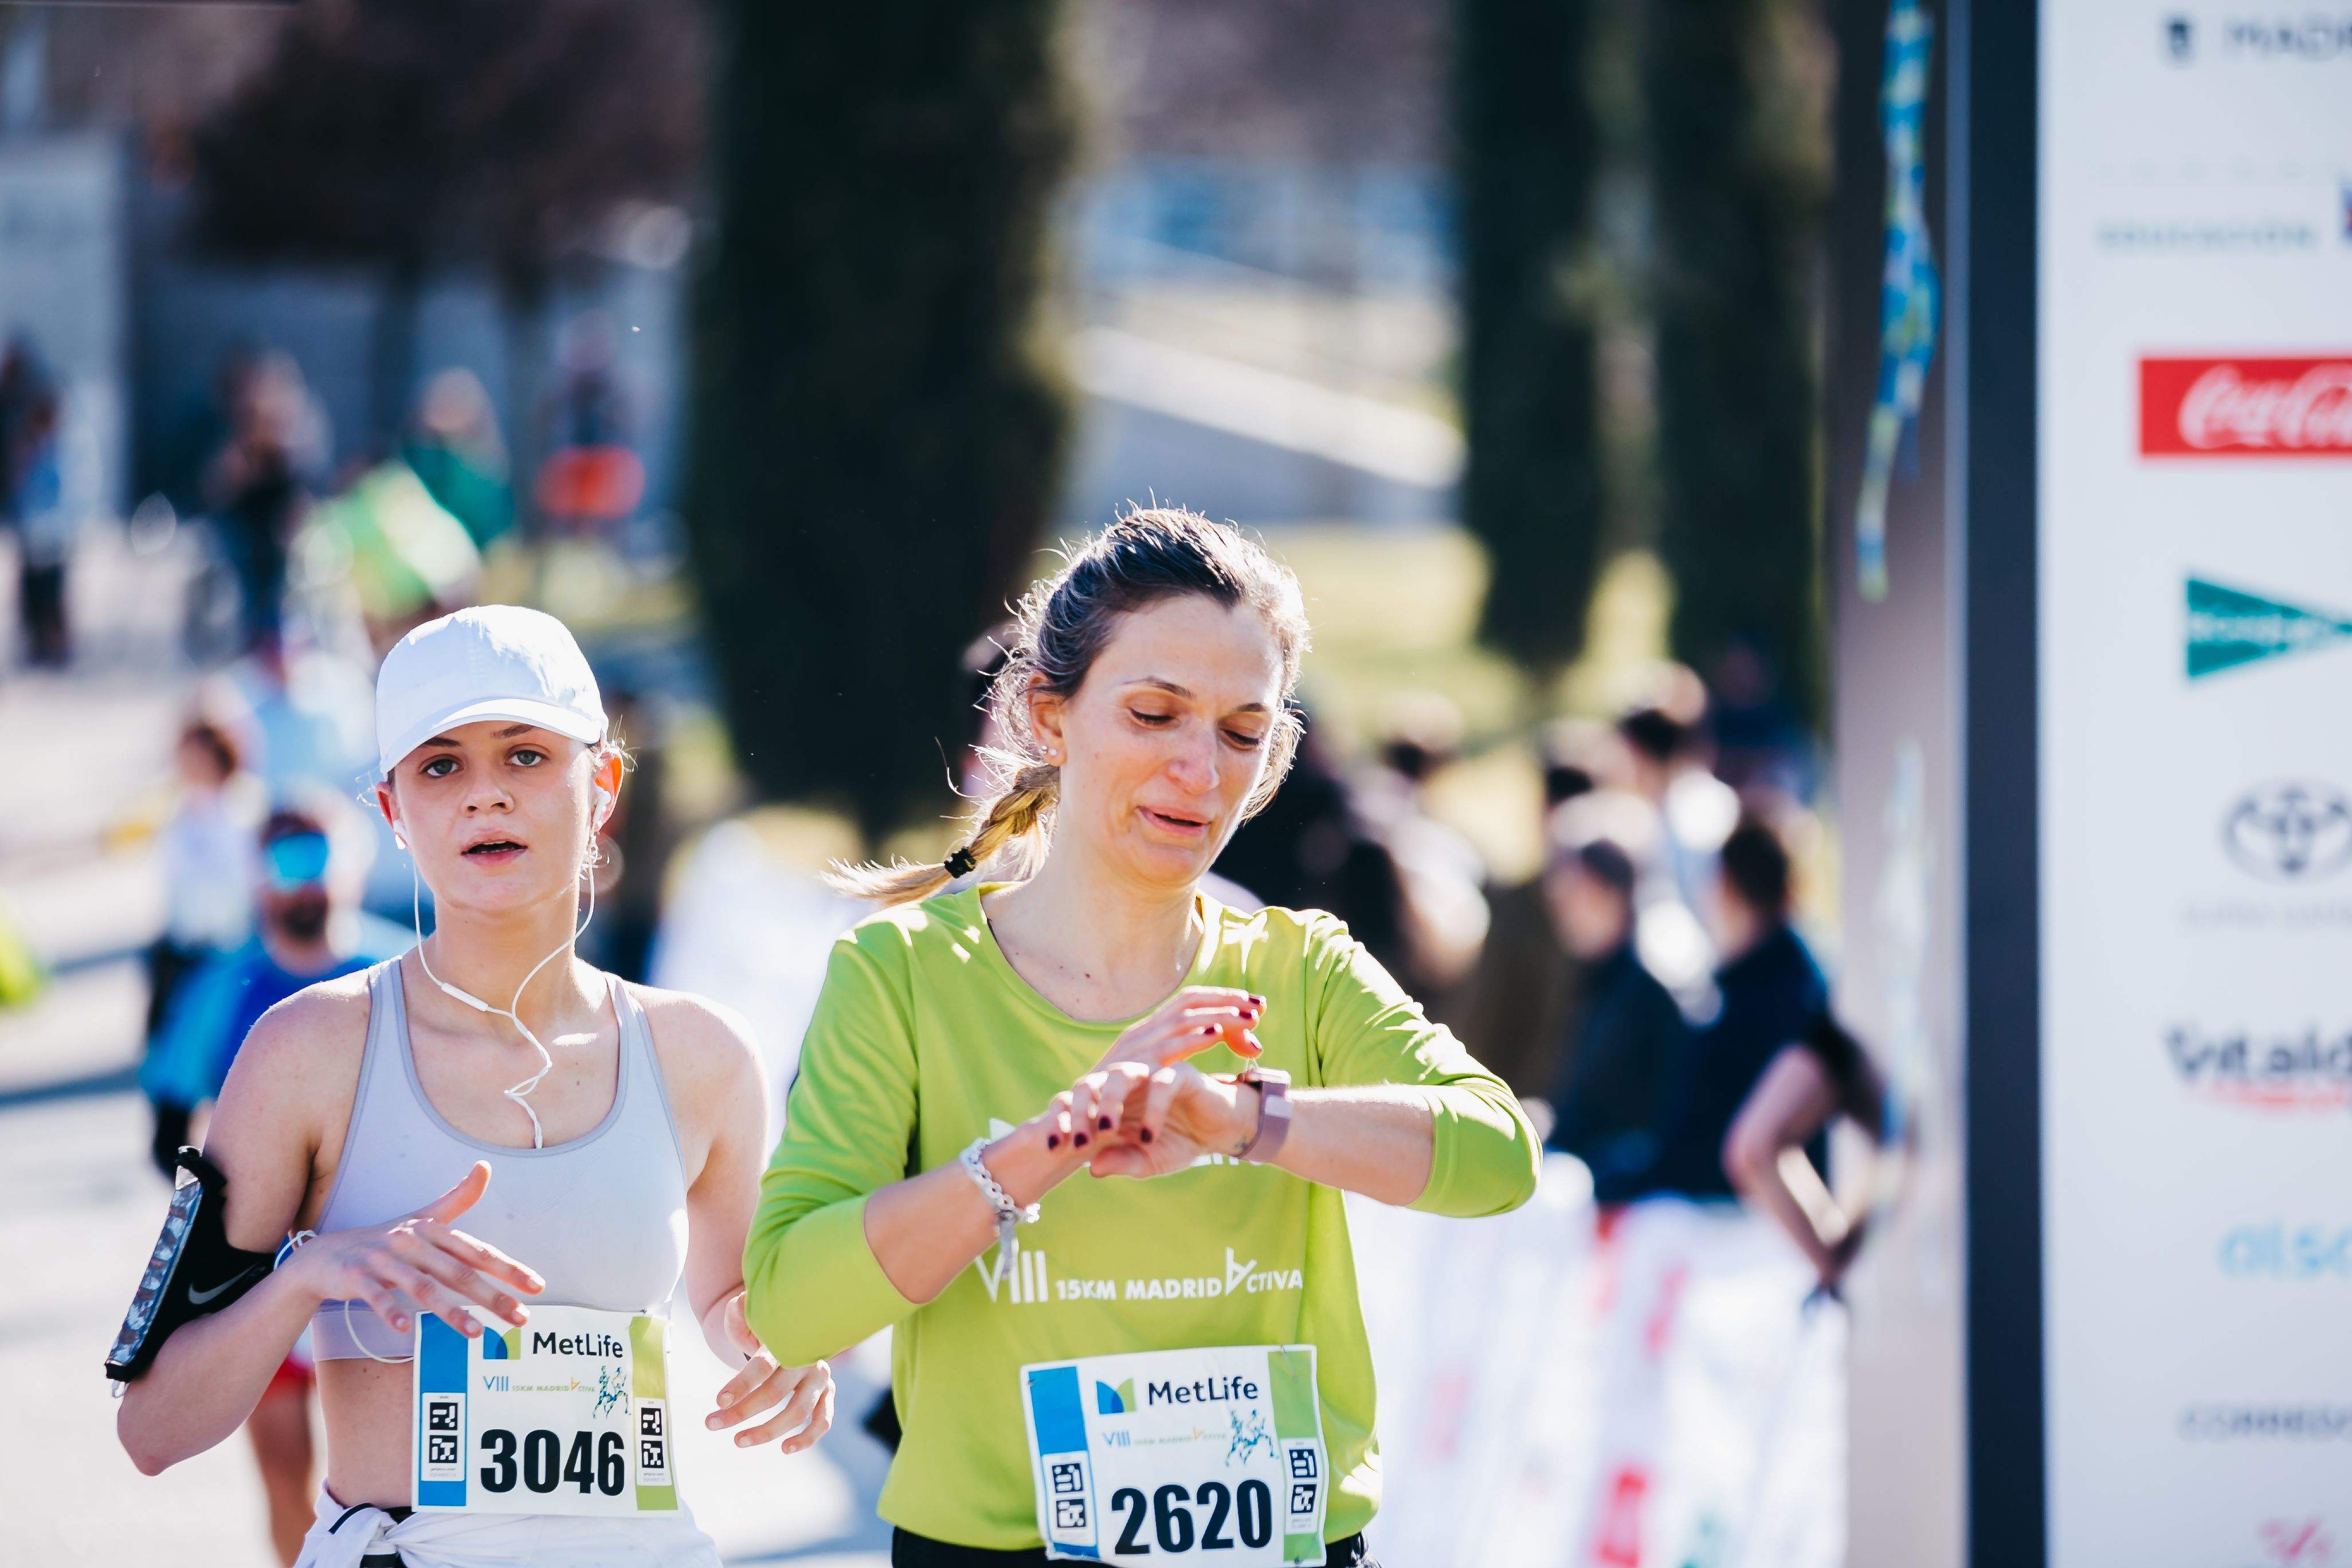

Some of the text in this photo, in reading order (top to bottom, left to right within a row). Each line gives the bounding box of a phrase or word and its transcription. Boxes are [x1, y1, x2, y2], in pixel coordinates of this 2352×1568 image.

[975, 1249, 1049, 1303] VIII
[1056, 1279, 1117, 1300] 15KM
[1125, 1277, 1223, 1300] MADRID
[533, 1332, 624, 1358] MetLife
[483, 1375, 509, 1393] VIII
[1147, 1375, 1259, 1408] MetLife
[1101, 1430, 1131, 1448] VIII
[480, 1429, 625, 1496] 3046
[1111, 1479, 1273, 1555] 2620
